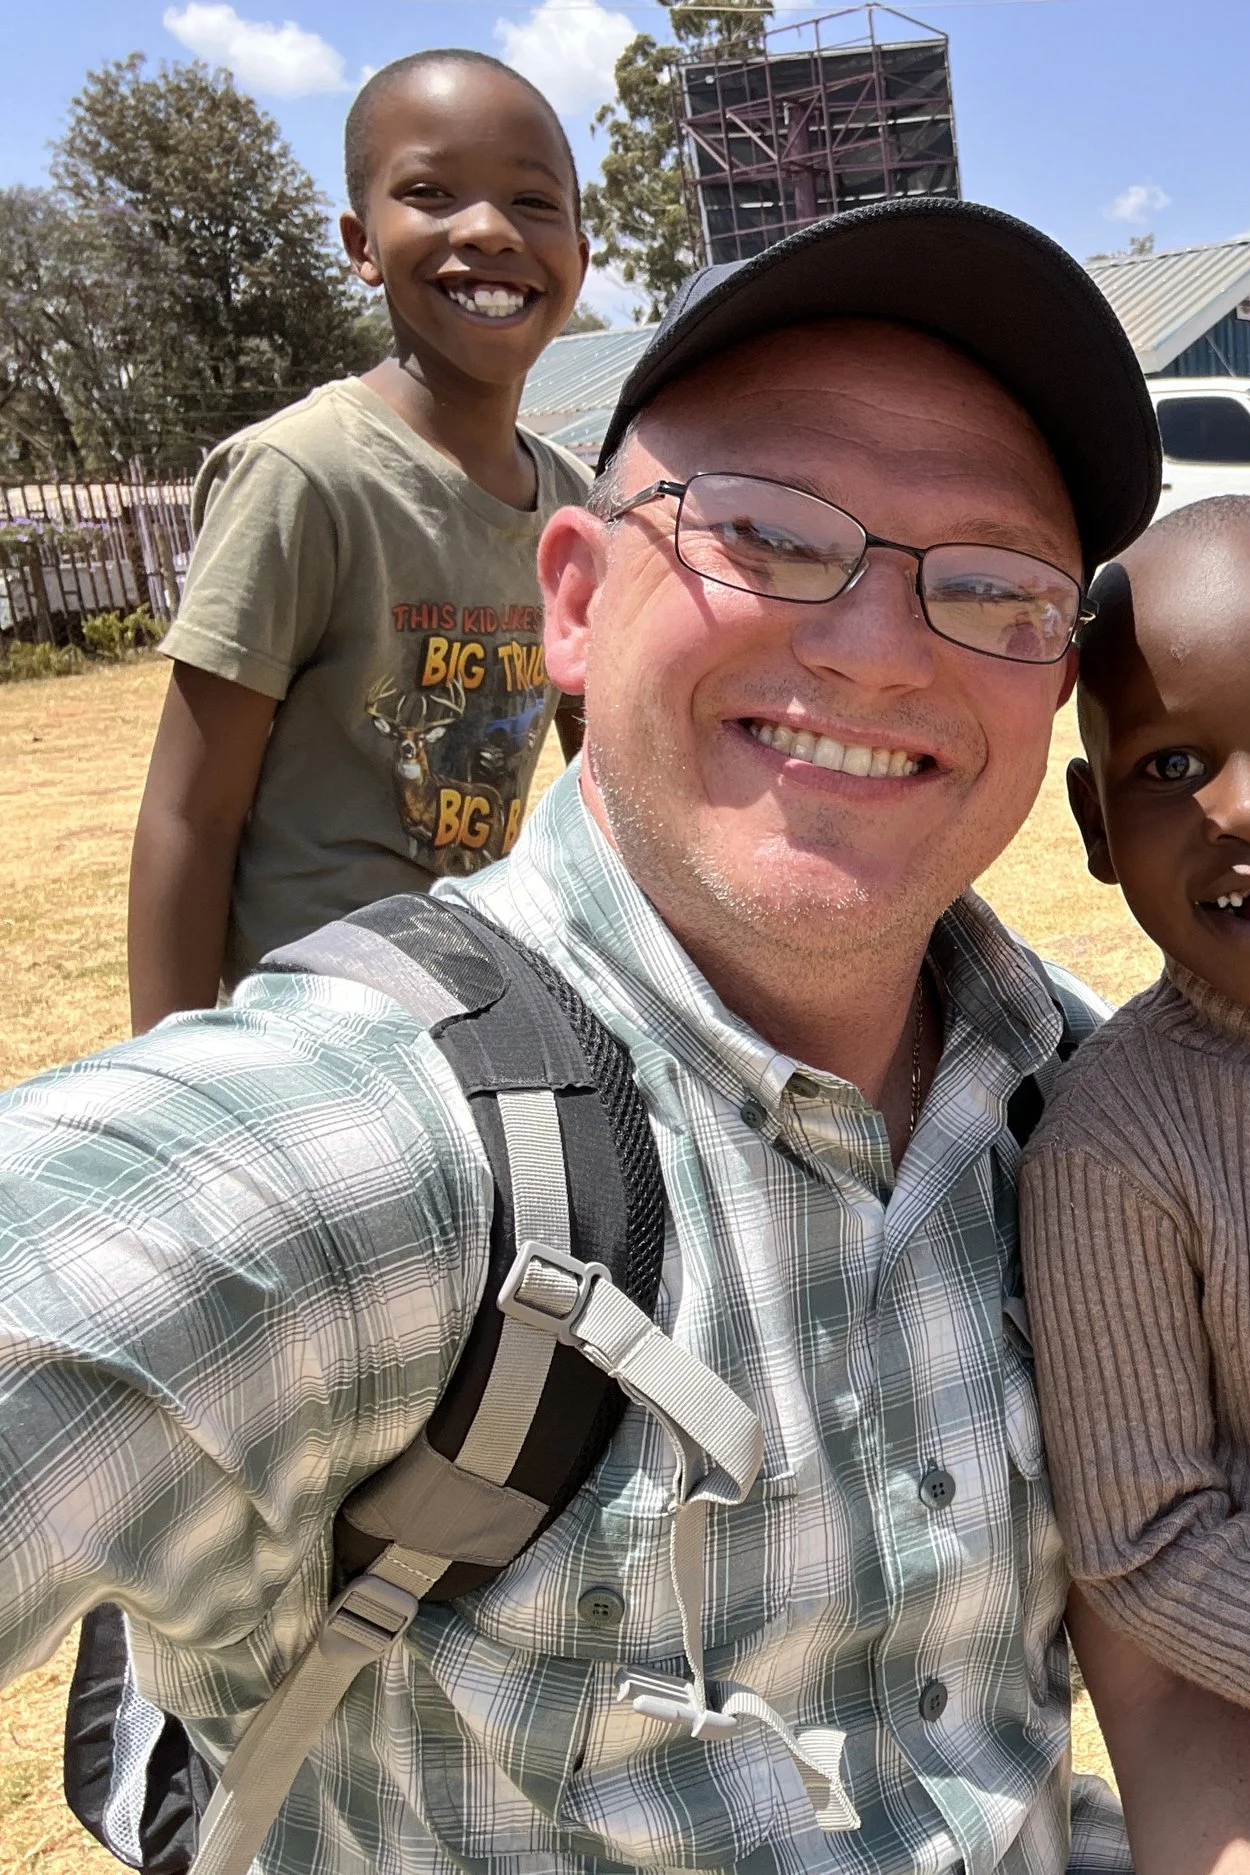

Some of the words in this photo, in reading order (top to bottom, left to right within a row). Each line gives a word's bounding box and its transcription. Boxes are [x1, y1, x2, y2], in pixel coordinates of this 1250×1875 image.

[392, 603, 456, 631] THIS
[463, 607, 498, 633] KID
[421, 636, 486, 690] BIG
[434, 788, 491, 848] BIG
